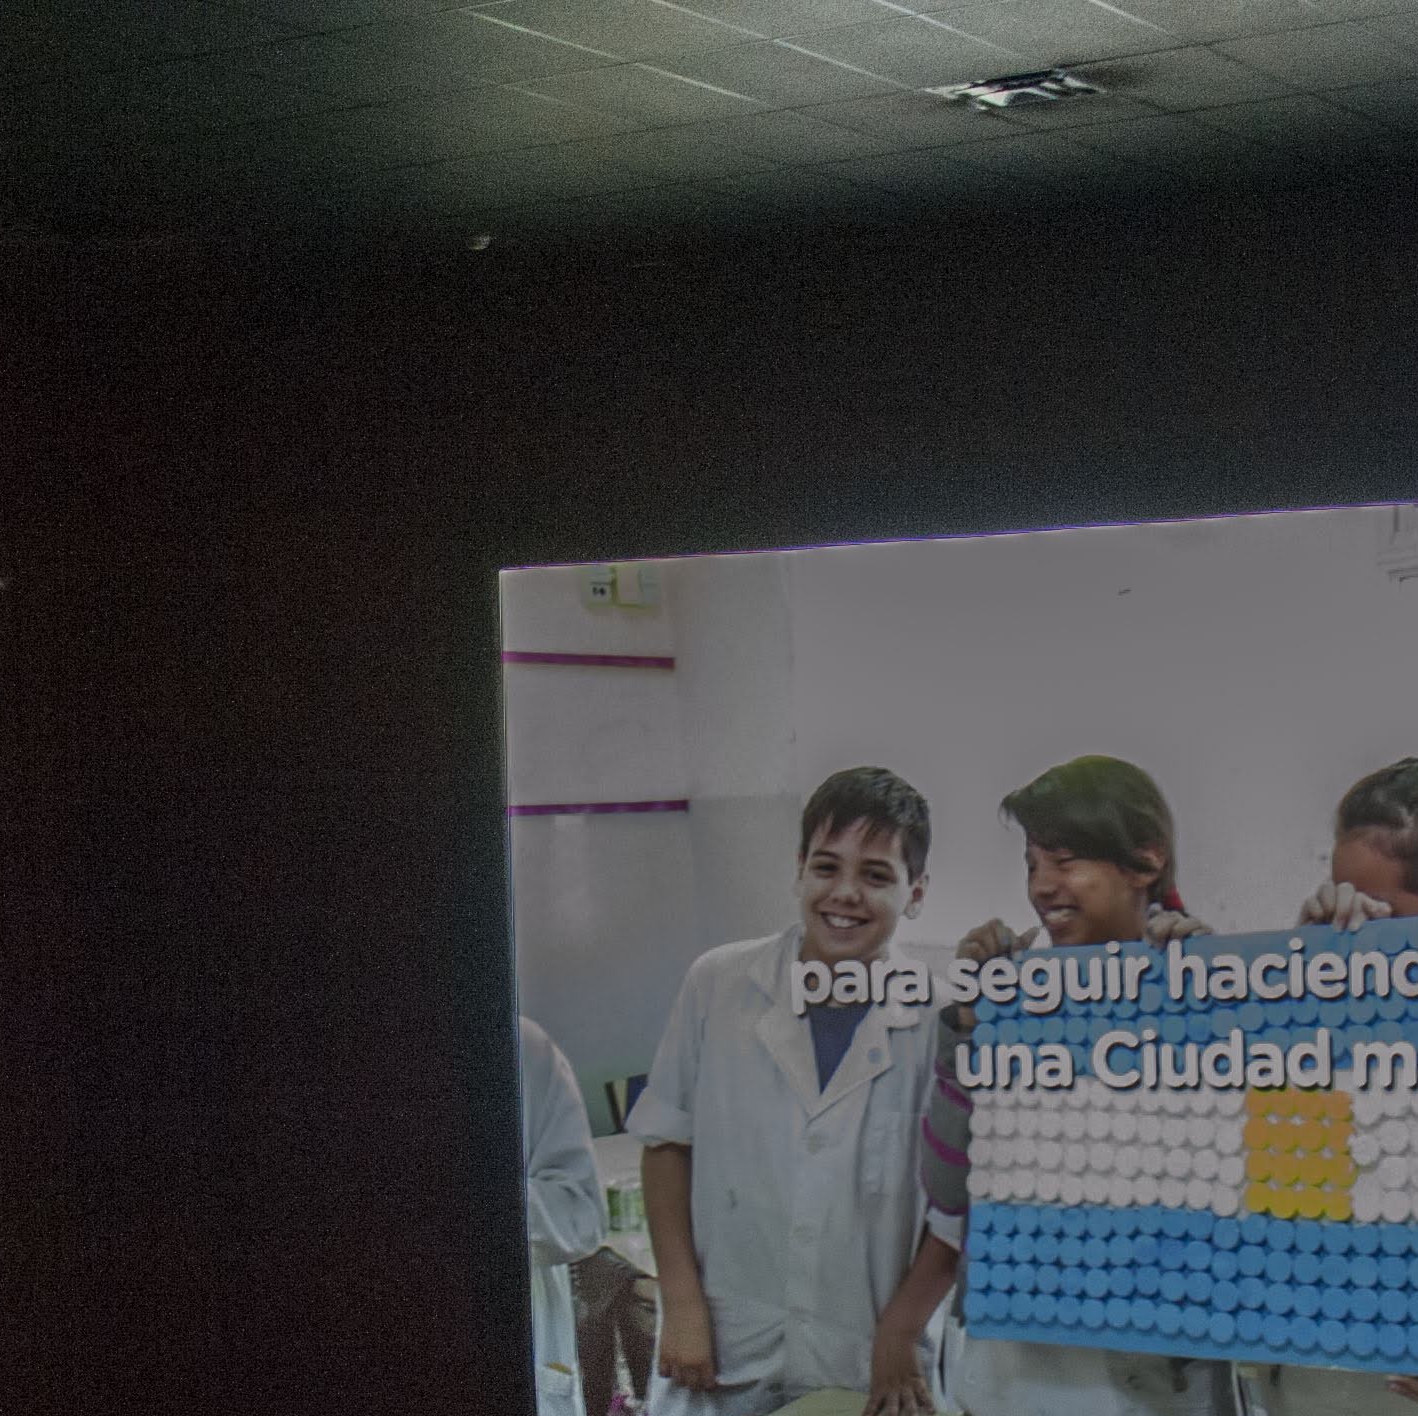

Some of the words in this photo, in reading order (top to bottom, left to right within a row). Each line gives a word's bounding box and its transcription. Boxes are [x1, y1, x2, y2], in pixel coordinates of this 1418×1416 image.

[790, 957, 932, 1017] para
[947, 941, 1150, 1015] seguir
[955, 1042, 1073, 1089] una
[1092, 1028, 1332, 1090] Ciudad
